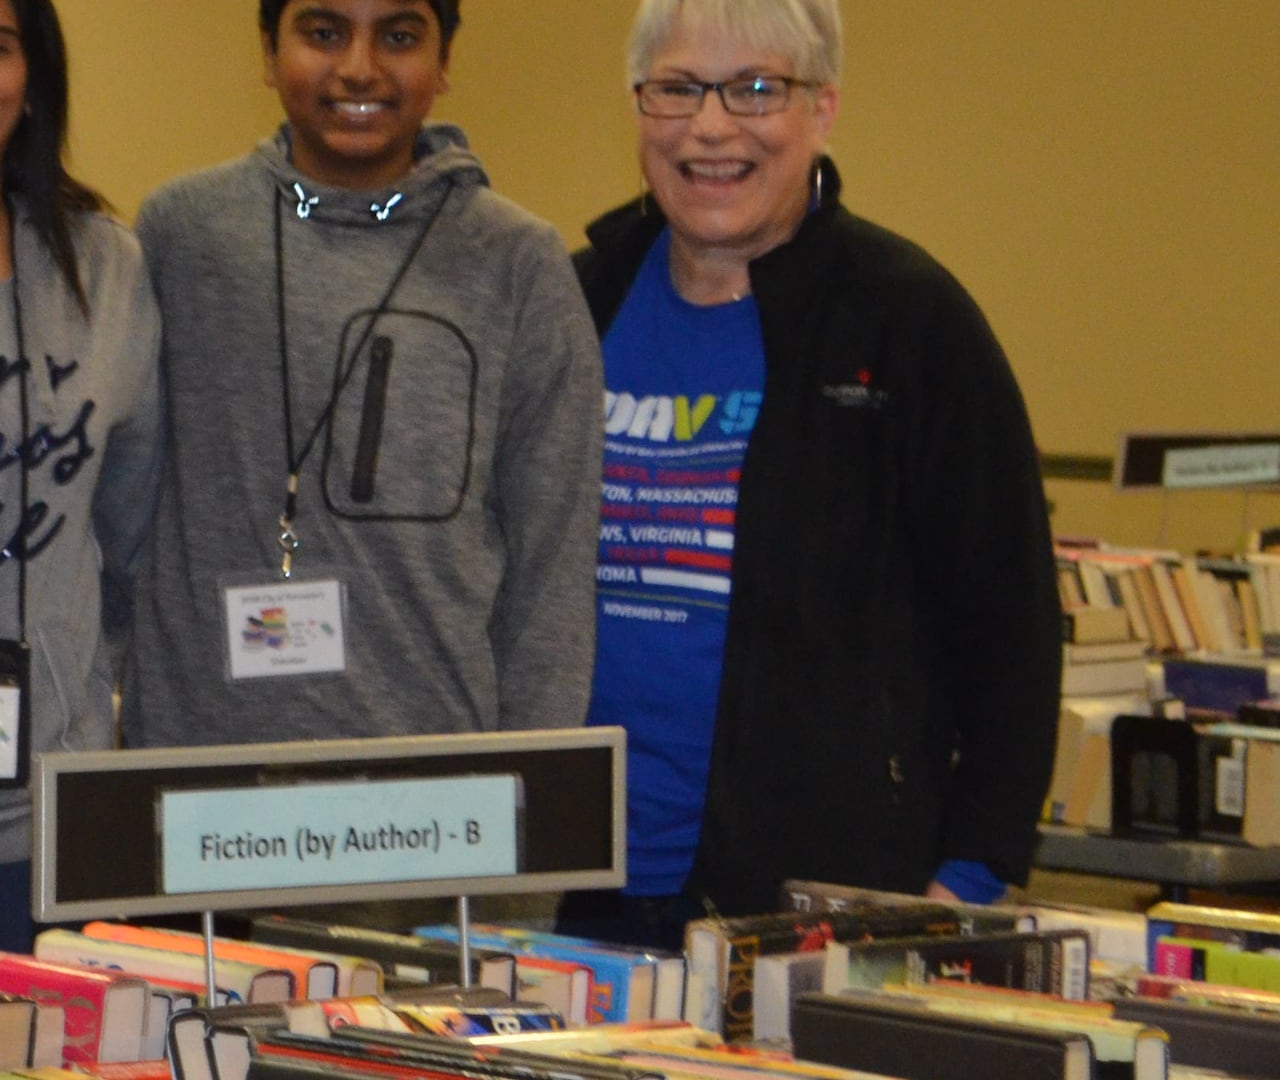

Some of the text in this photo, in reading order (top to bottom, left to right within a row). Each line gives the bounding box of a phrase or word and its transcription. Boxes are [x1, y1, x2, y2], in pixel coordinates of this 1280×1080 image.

[630, 526, 702, 546] VIRGINIA
[603, 602, 662, 621] NOVEMBER
[199, 831, 288, 863] Fiction
[295, 825, 337, 865] (by
[342, 819, 442, 856] Author)
[464, 819, 481, 845] B
